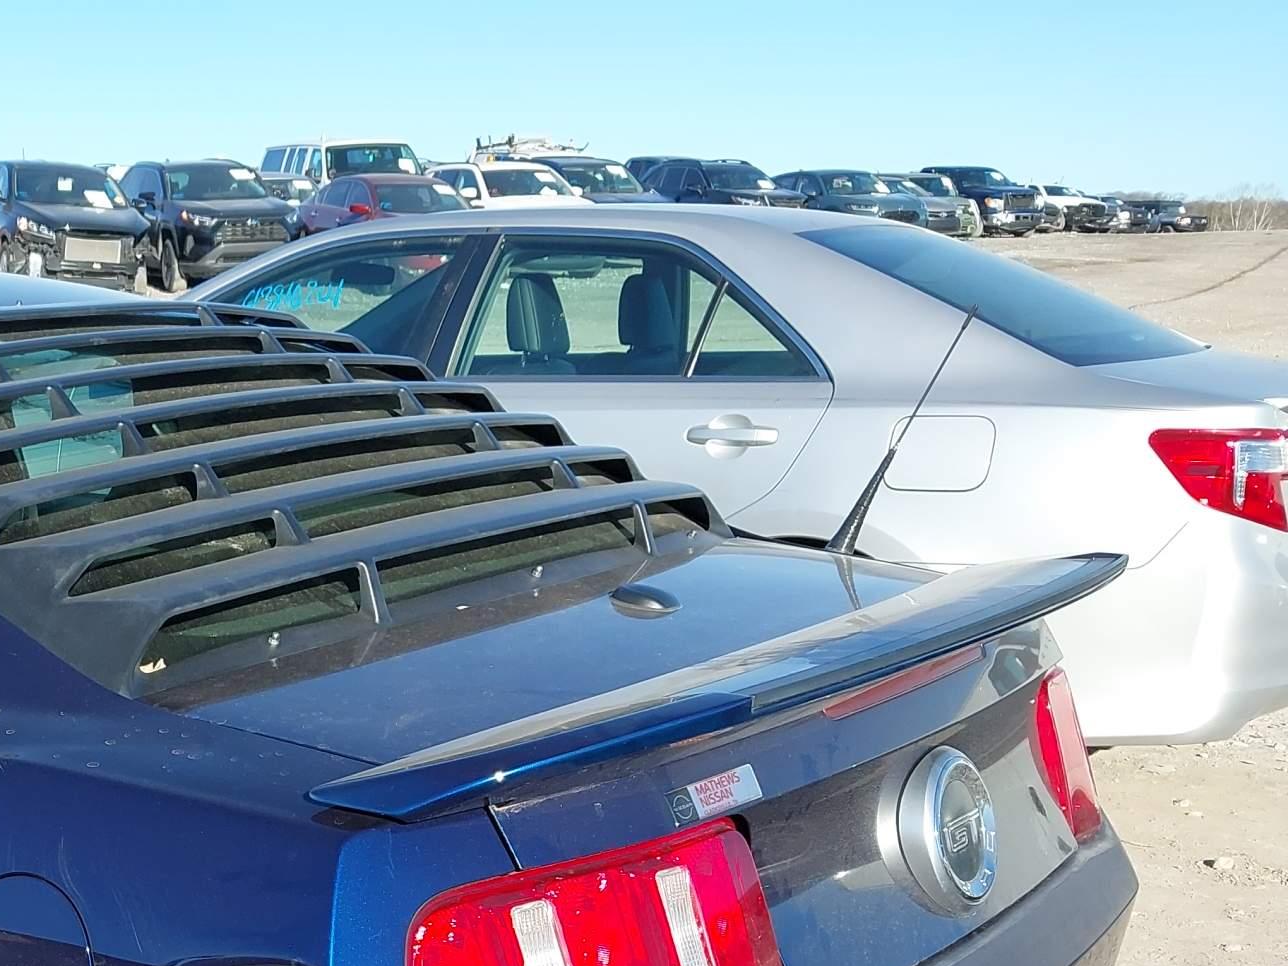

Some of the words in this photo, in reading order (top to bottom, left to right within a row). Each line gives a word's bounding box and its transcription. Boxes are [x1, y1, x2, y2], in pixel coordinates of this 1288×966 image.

[694, 772, 741, 797] MATHEWS
[699, 787, 734, 808] NISSAN
[944, 808, 980, 853] GT
